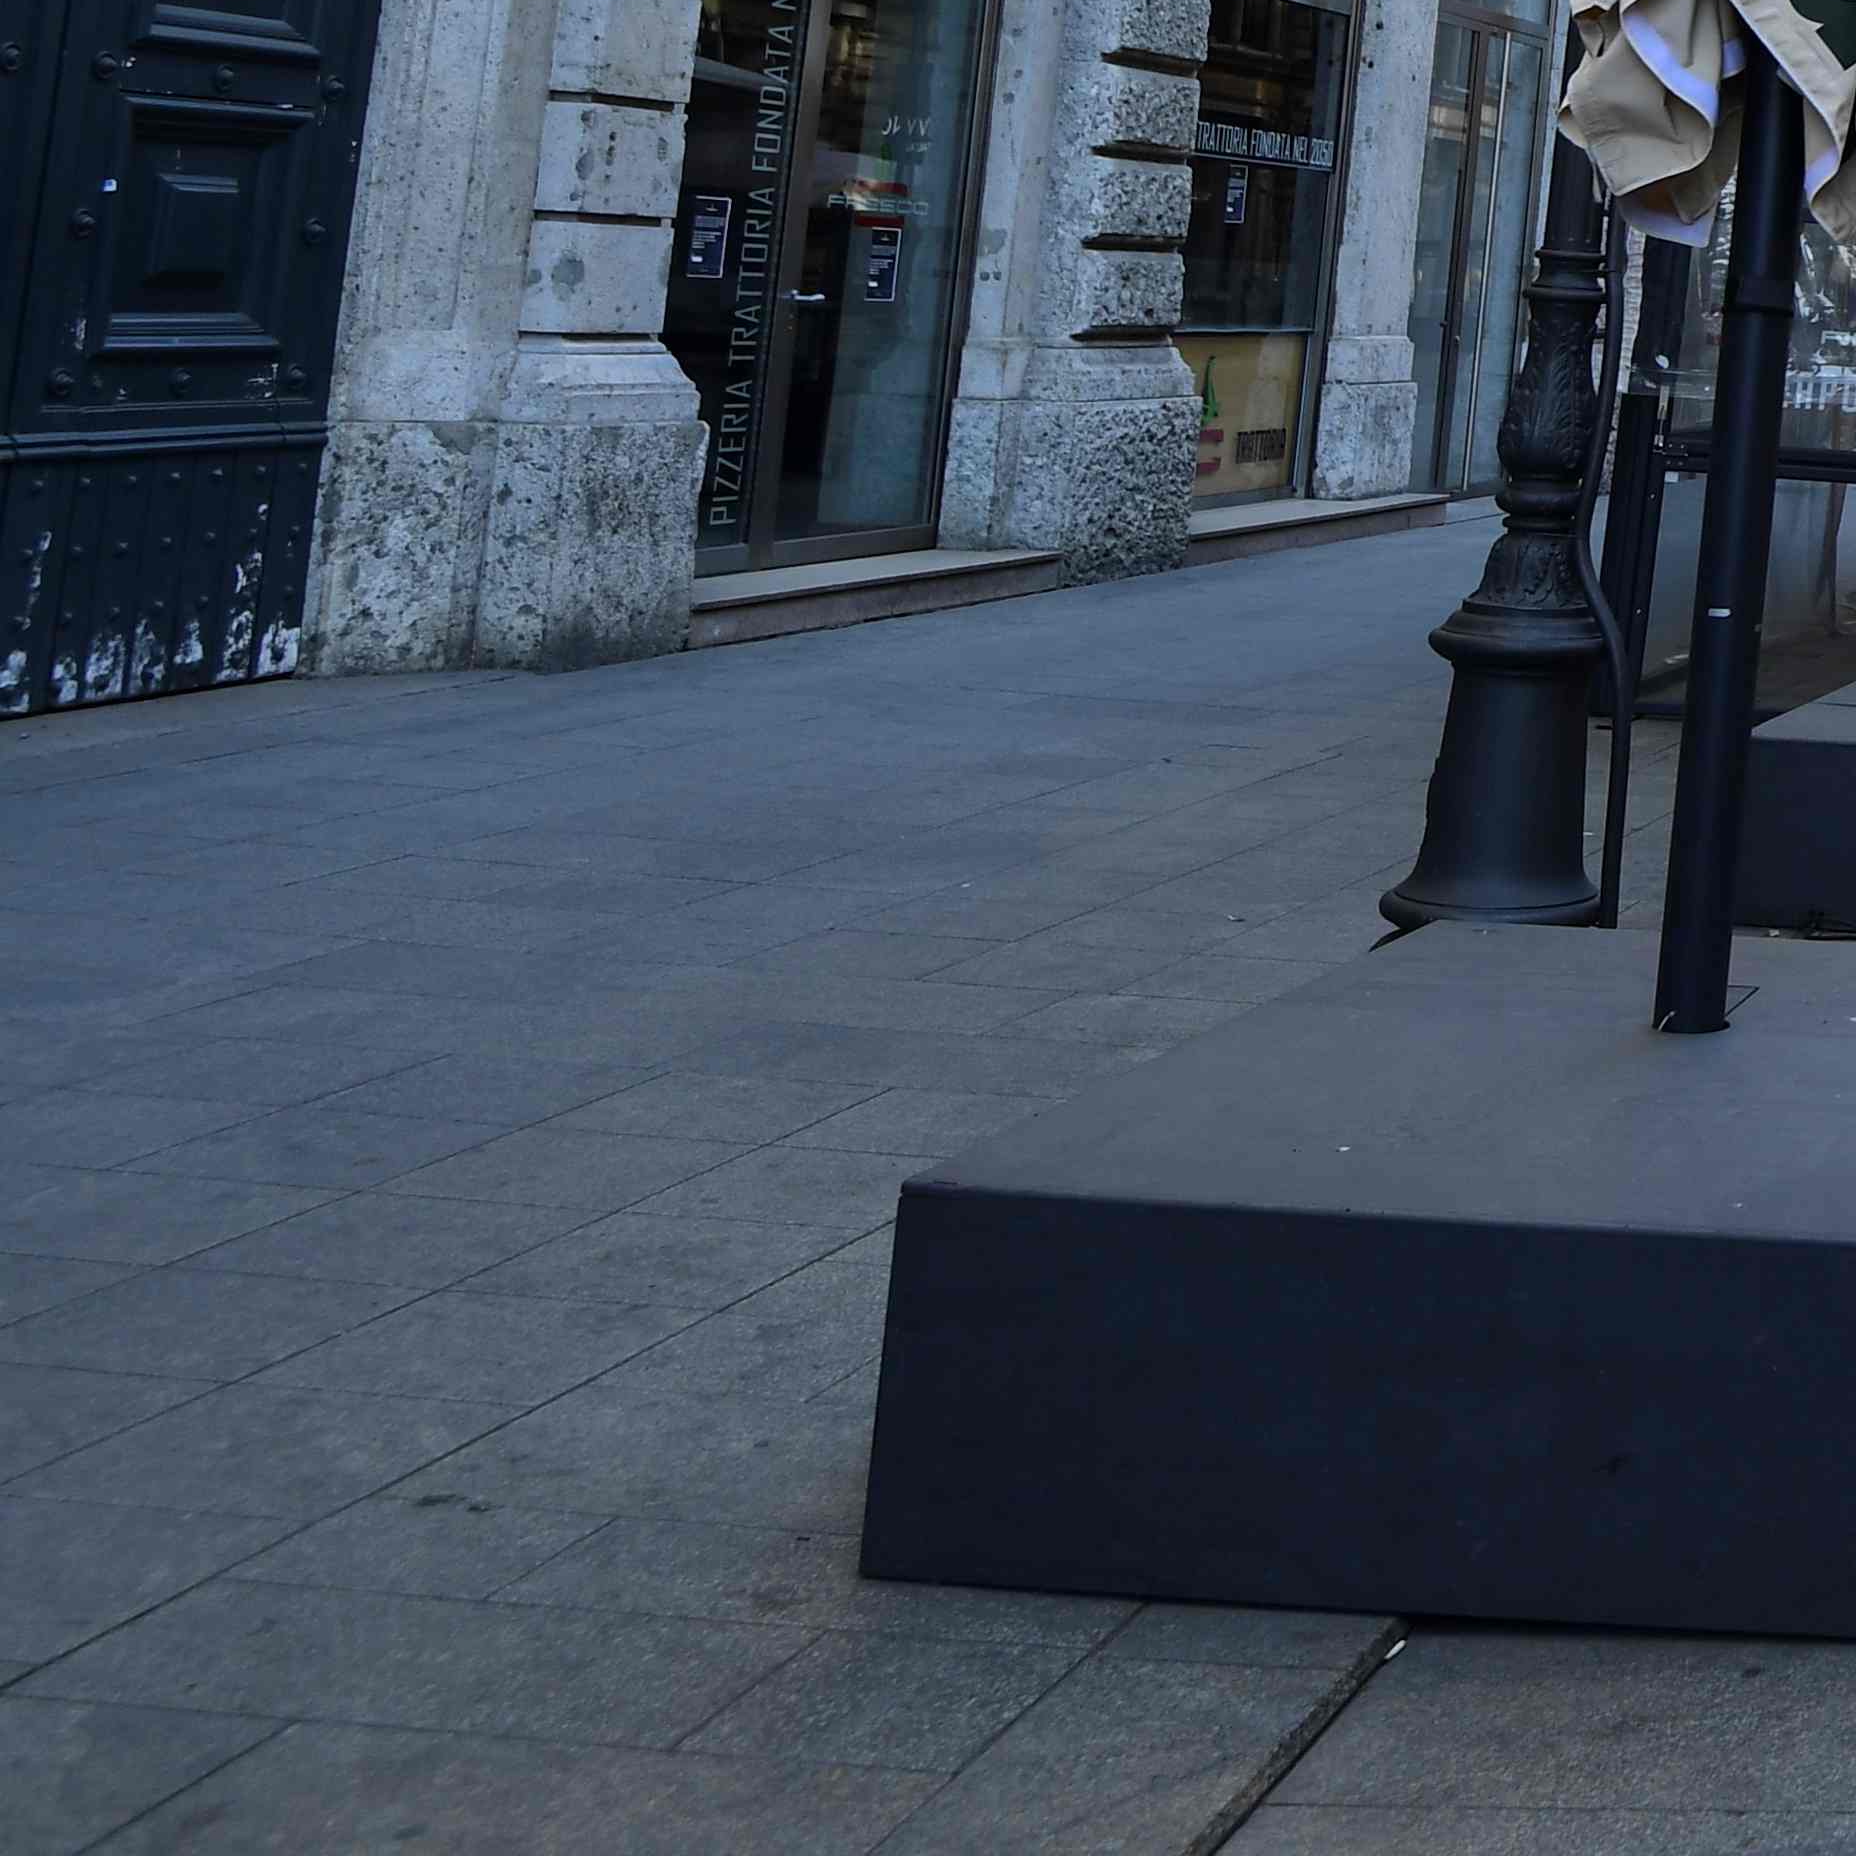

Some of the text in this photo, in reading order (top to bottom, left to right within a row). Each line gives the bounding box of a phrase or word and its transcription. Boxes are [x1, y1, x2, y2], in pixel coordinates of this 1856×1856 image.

[751, 23, 795, 174] FONDATA
[1198, 120, 1248, 156] TRATTORIA
[1249, 128, 1291, 162] FONDATA
[1292, 135, 1309, 164] NEL
[729, 186, 777, 367] TRATTORIA
[708, 379, 753, 526] PIZZERIA
